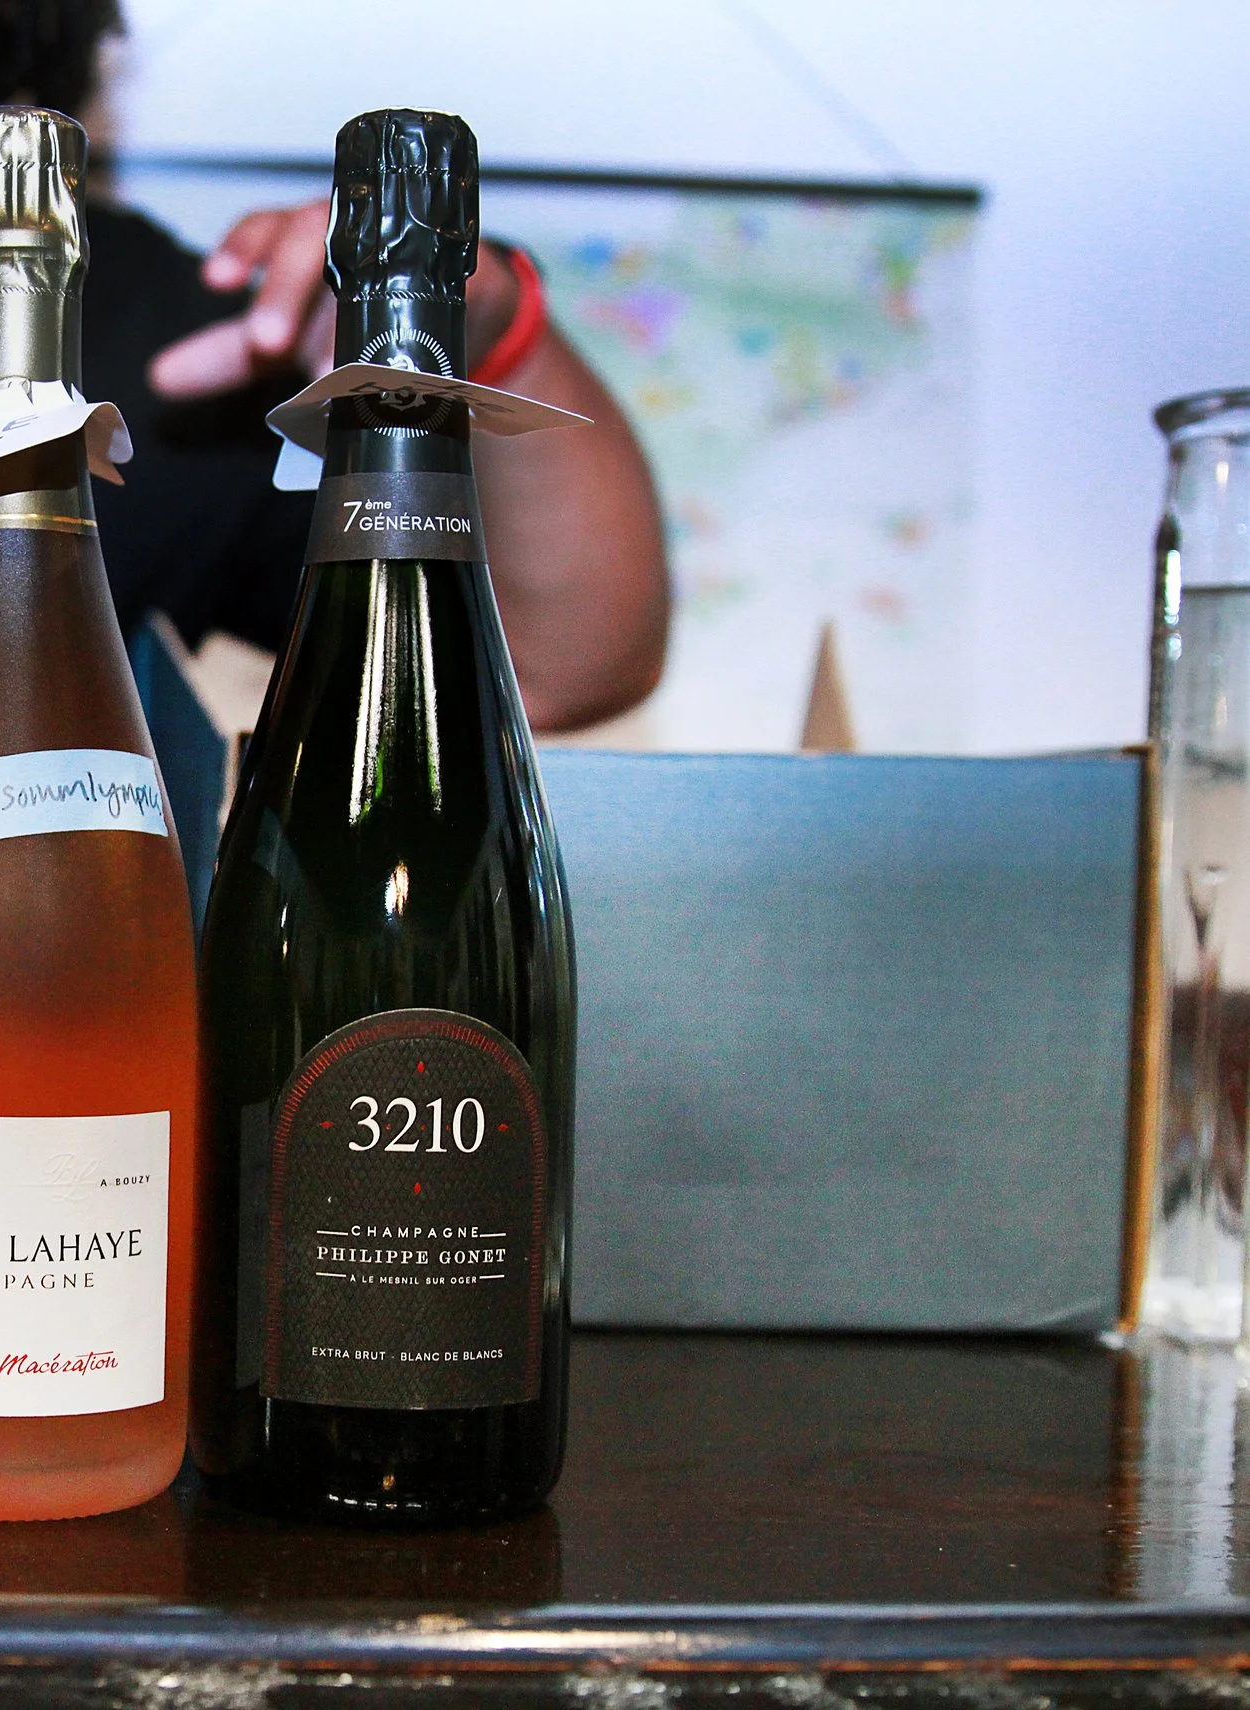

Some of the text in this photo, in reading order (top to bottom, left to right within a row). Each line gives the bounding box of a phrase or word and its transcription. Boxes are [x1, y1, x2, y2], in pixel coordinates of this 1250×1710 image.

[358, 511, 472, 534] GÉNÉRATION
[348, 1095, 486, 1154] 3210
[115, 1174, 151, 1186] BOUZY
[350, 1225, 479, 1239] CHAMPAGNE
[9, 1228, 143, 1263] LAHAYE
[316, 1246, 507, 1265] PHILIPPE GONET
[361, 1275, 375, 1284] LE
[379, 1276, 420, 1285] MESNIL
[425, 1276, 445, 1285] SUR
[450, 1276, 478, 1285] OGER
[311, 1346, 504, 1362] EXTRA BRUT BLANC DE BLANCS
